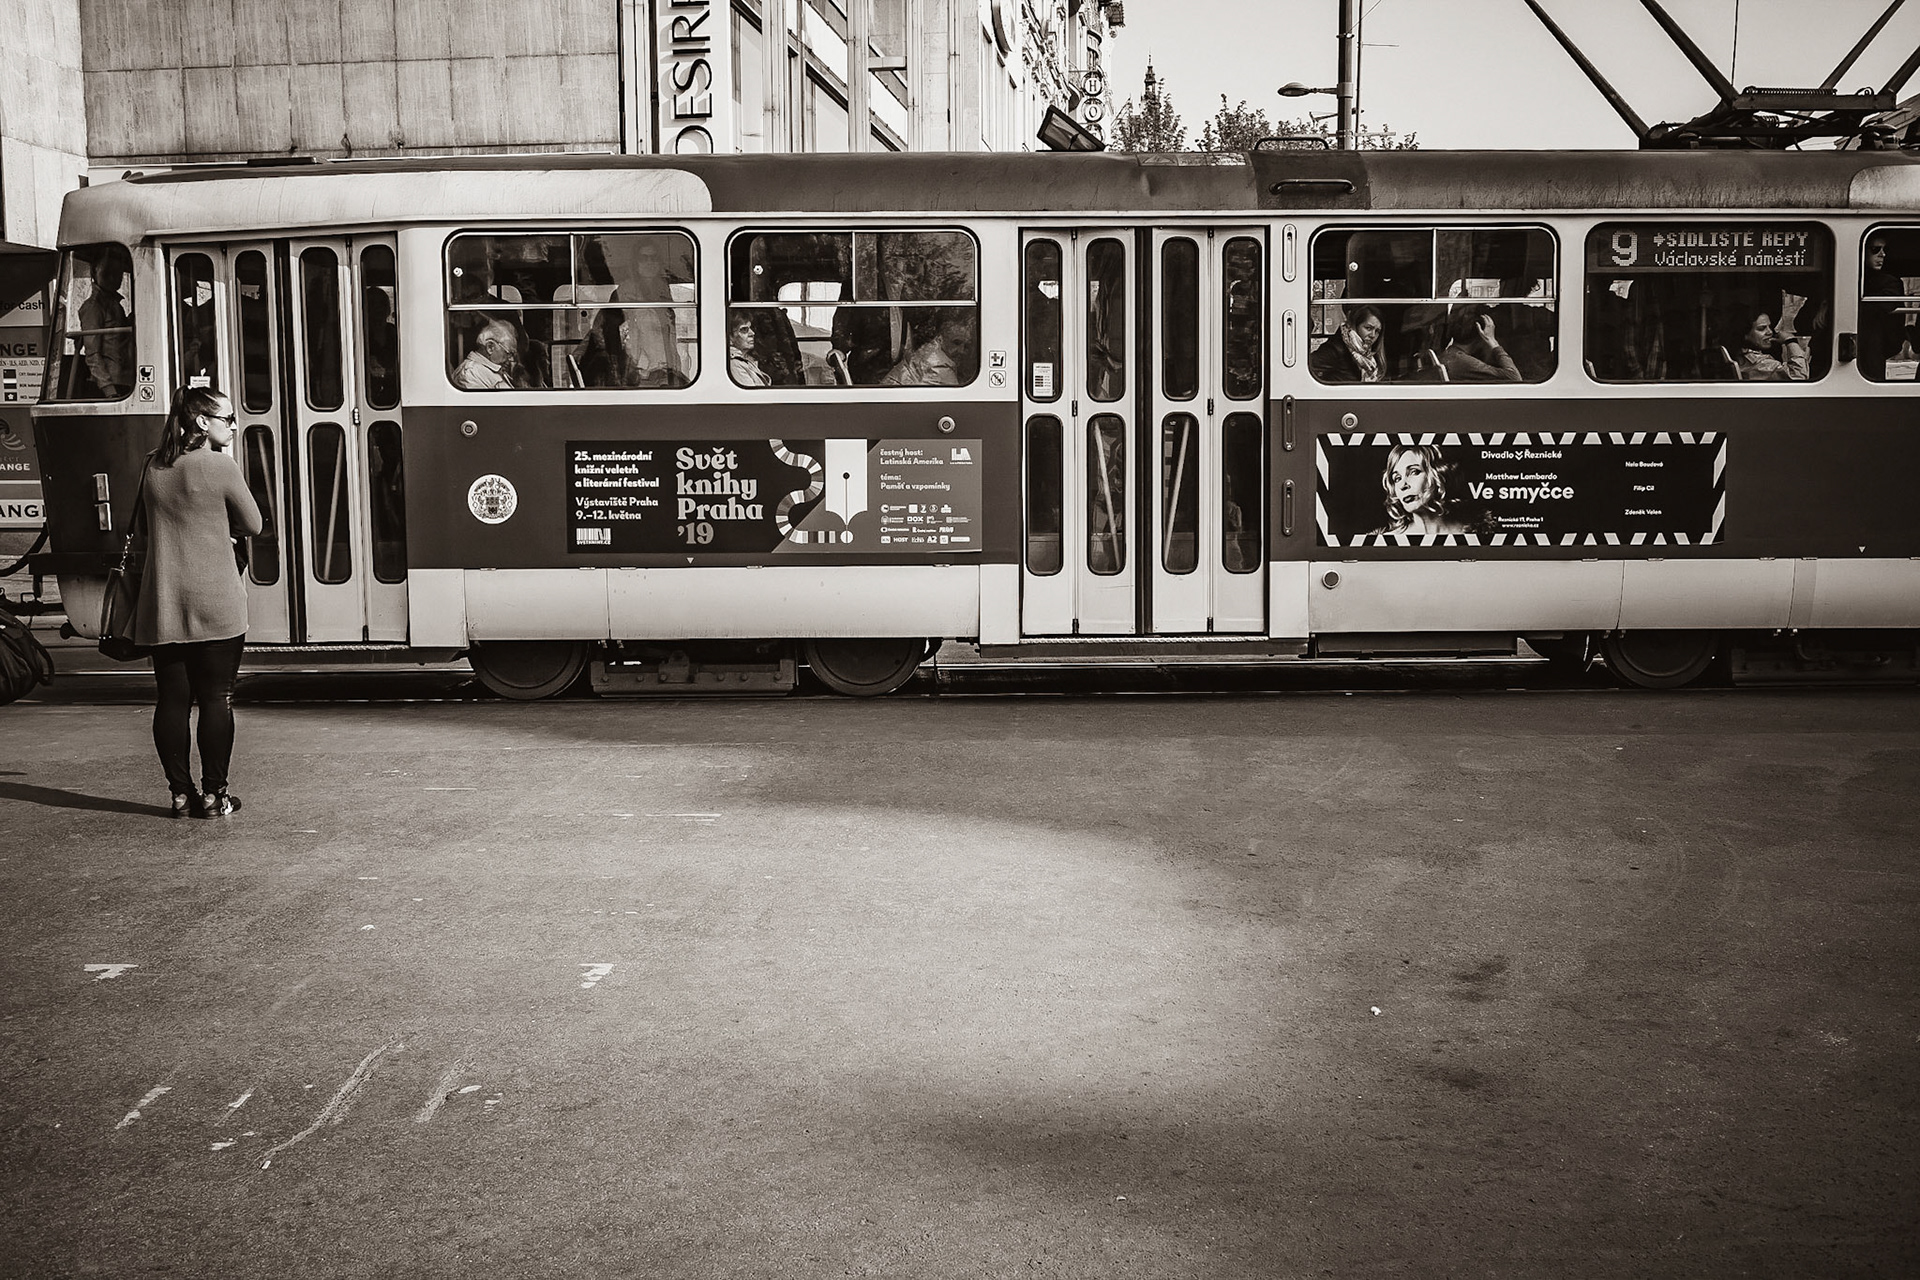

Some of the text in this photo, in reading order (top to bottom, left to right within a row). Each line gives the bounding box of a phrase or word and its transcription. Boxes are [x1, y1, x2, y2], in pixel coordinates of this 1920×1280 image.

[672, 0, 713, 154] DESIR
[1611, 230, 1638, 266] 9
[1654, 249, 1807, 266] Václavské náměstí
[18, 299, 46, 310] cash
[574, 450, 653, 461] 25. mezinárodní
[880, 448, 923, 457] čestný host:
[1481, 449, 1562, 459] Divadlo Řeznické
[676, 447, 738, 470] Svět
[880, 457, 912, 465] Latinská
[912, 457, 944, 465] Amerika
[574, 464, 639, 474] knižní veletrh
[880, 473, 902, 481] téma:
[1520, 472, 1558, 480] Lombardo
[583, 477, 622, 487] literární
[623, 477, 660, 487] festival
[676, 471, 757, 500] knihy
[911, 482, 951, 491] vzpomínky
[1468, 481, 1575, 504] Ve smyčce
[575, 496, 659, 509] Výstaviště Praha
[677, 496, 764, 520] Praha
[608, 510, 642, 520] května
